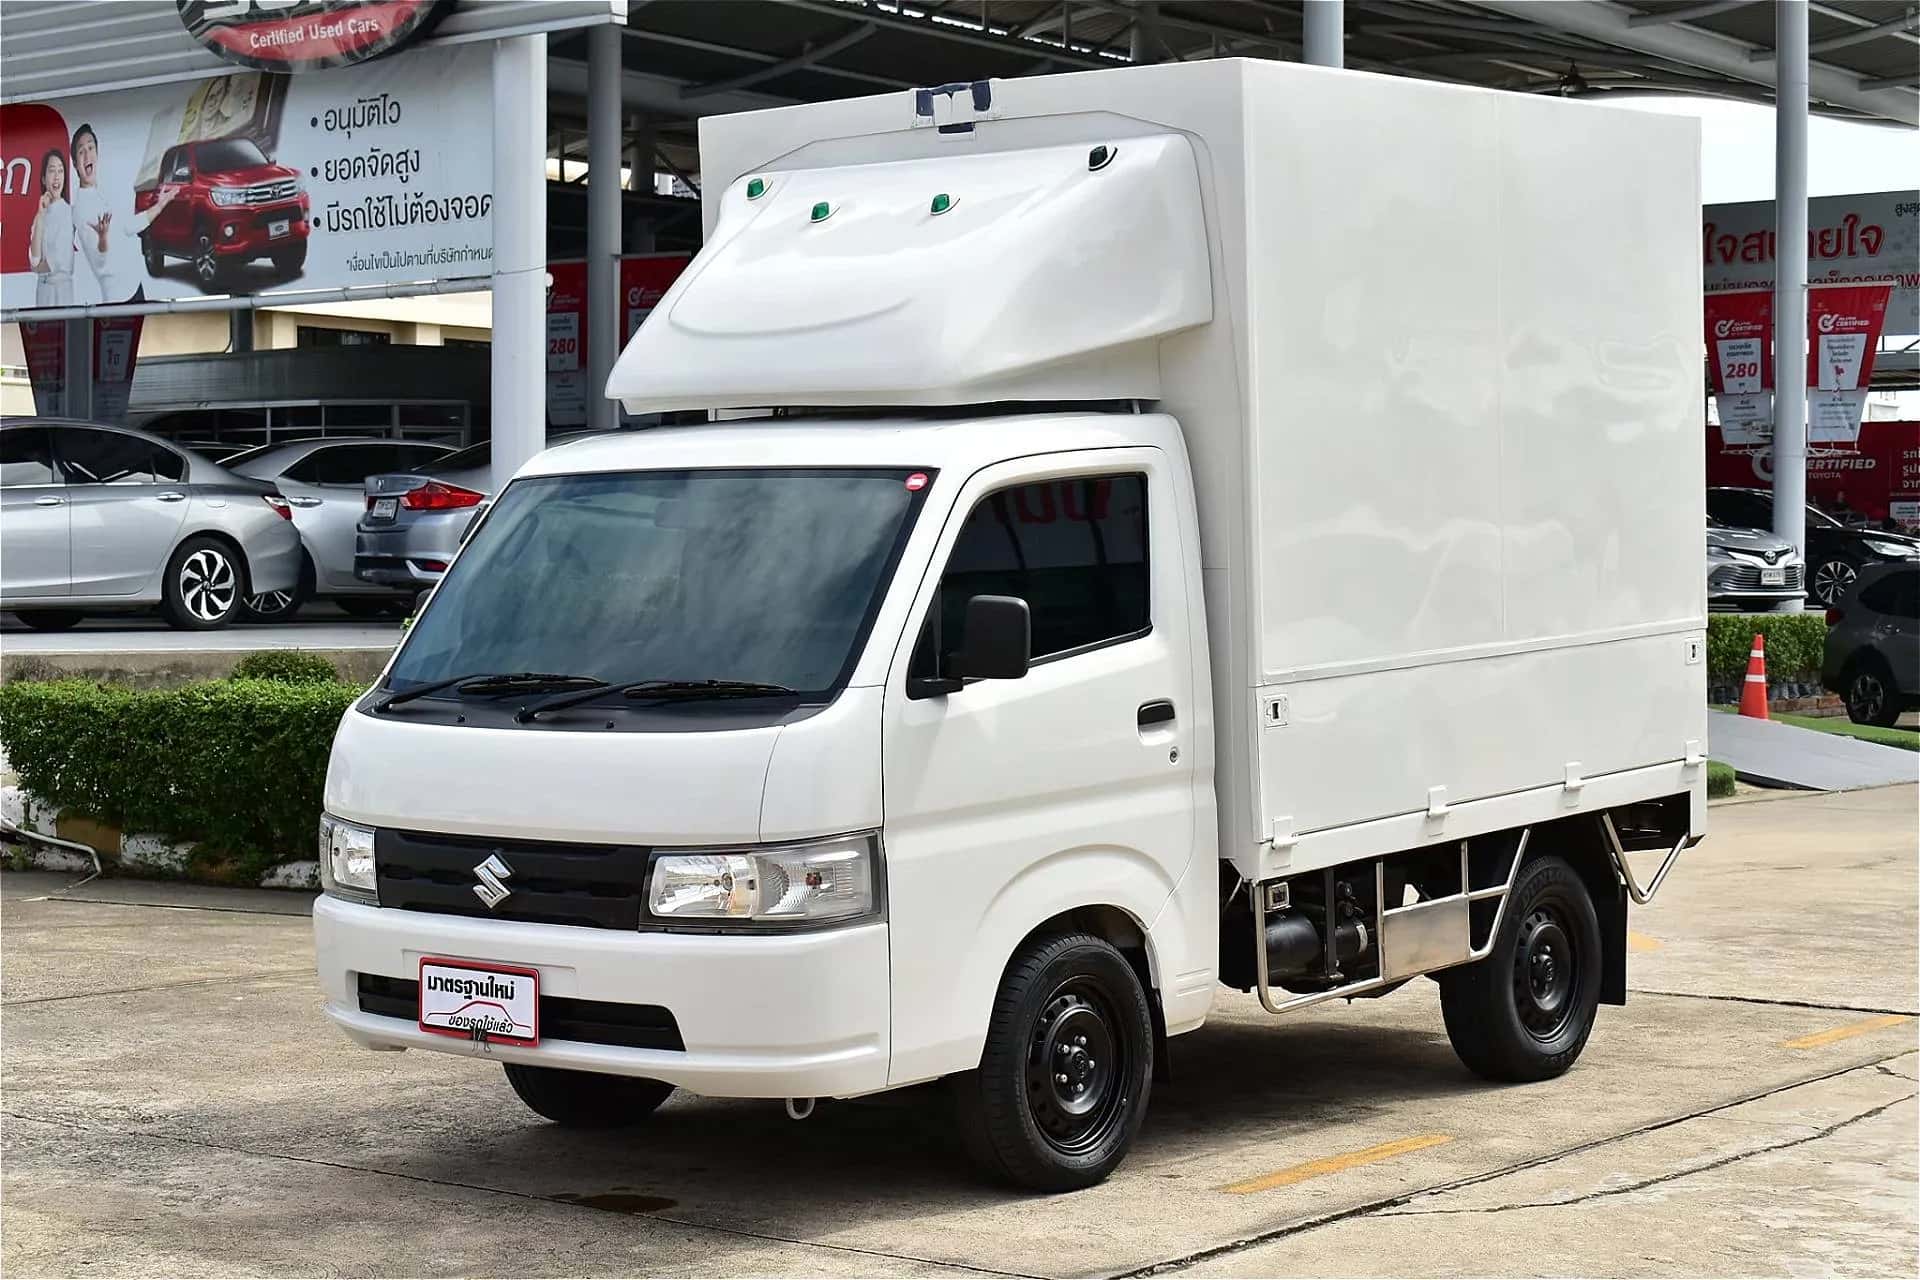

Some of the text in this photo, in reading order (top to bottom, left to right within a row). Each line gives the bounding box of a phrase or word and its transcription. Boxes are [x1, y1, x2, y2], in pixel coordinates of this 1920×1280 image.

[250, 18, 378, 48] Certified Used Cars
[324, 94, 401, 140] อนุมัติไว
[325, 147, 420, 183] ยอดจัดสูง
[550, 338, 576, 355] 280
[1725, 362, 1758, 379] 280
[1806, 458, 1876, 470] ERTIFIED
[427, 975, 515, 1000] มาตรฐานใหม่
[448, 1015, 513, 1034] ของรถใช้แล้ว
